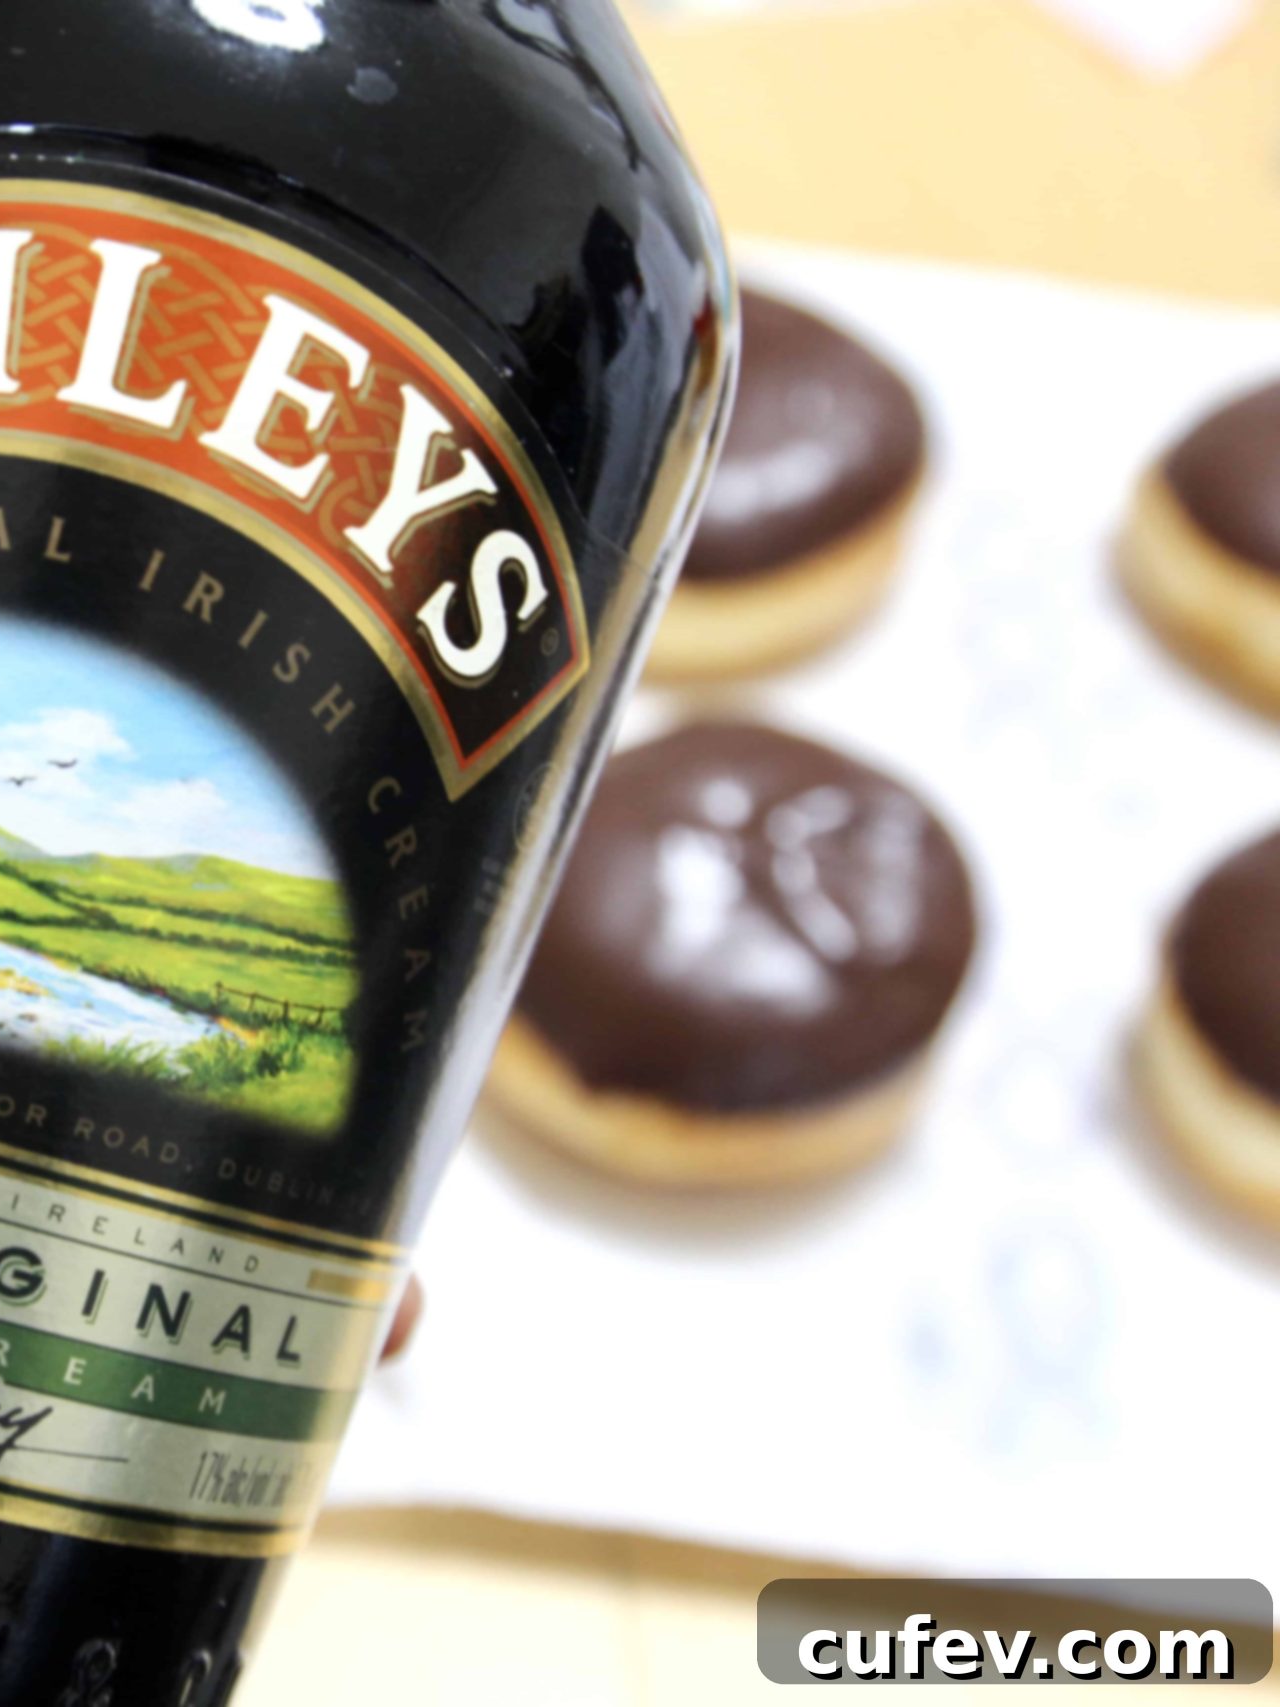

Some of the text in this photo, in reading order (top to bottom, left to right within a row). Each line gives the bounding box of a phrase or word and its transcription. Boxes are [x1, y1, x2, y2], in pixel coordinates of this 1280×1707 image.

[138, 549, 355, 732] IRISH
[367, 774, 432, 1052] CREAM
[9, 1193, 260, 1274] IRELAND
